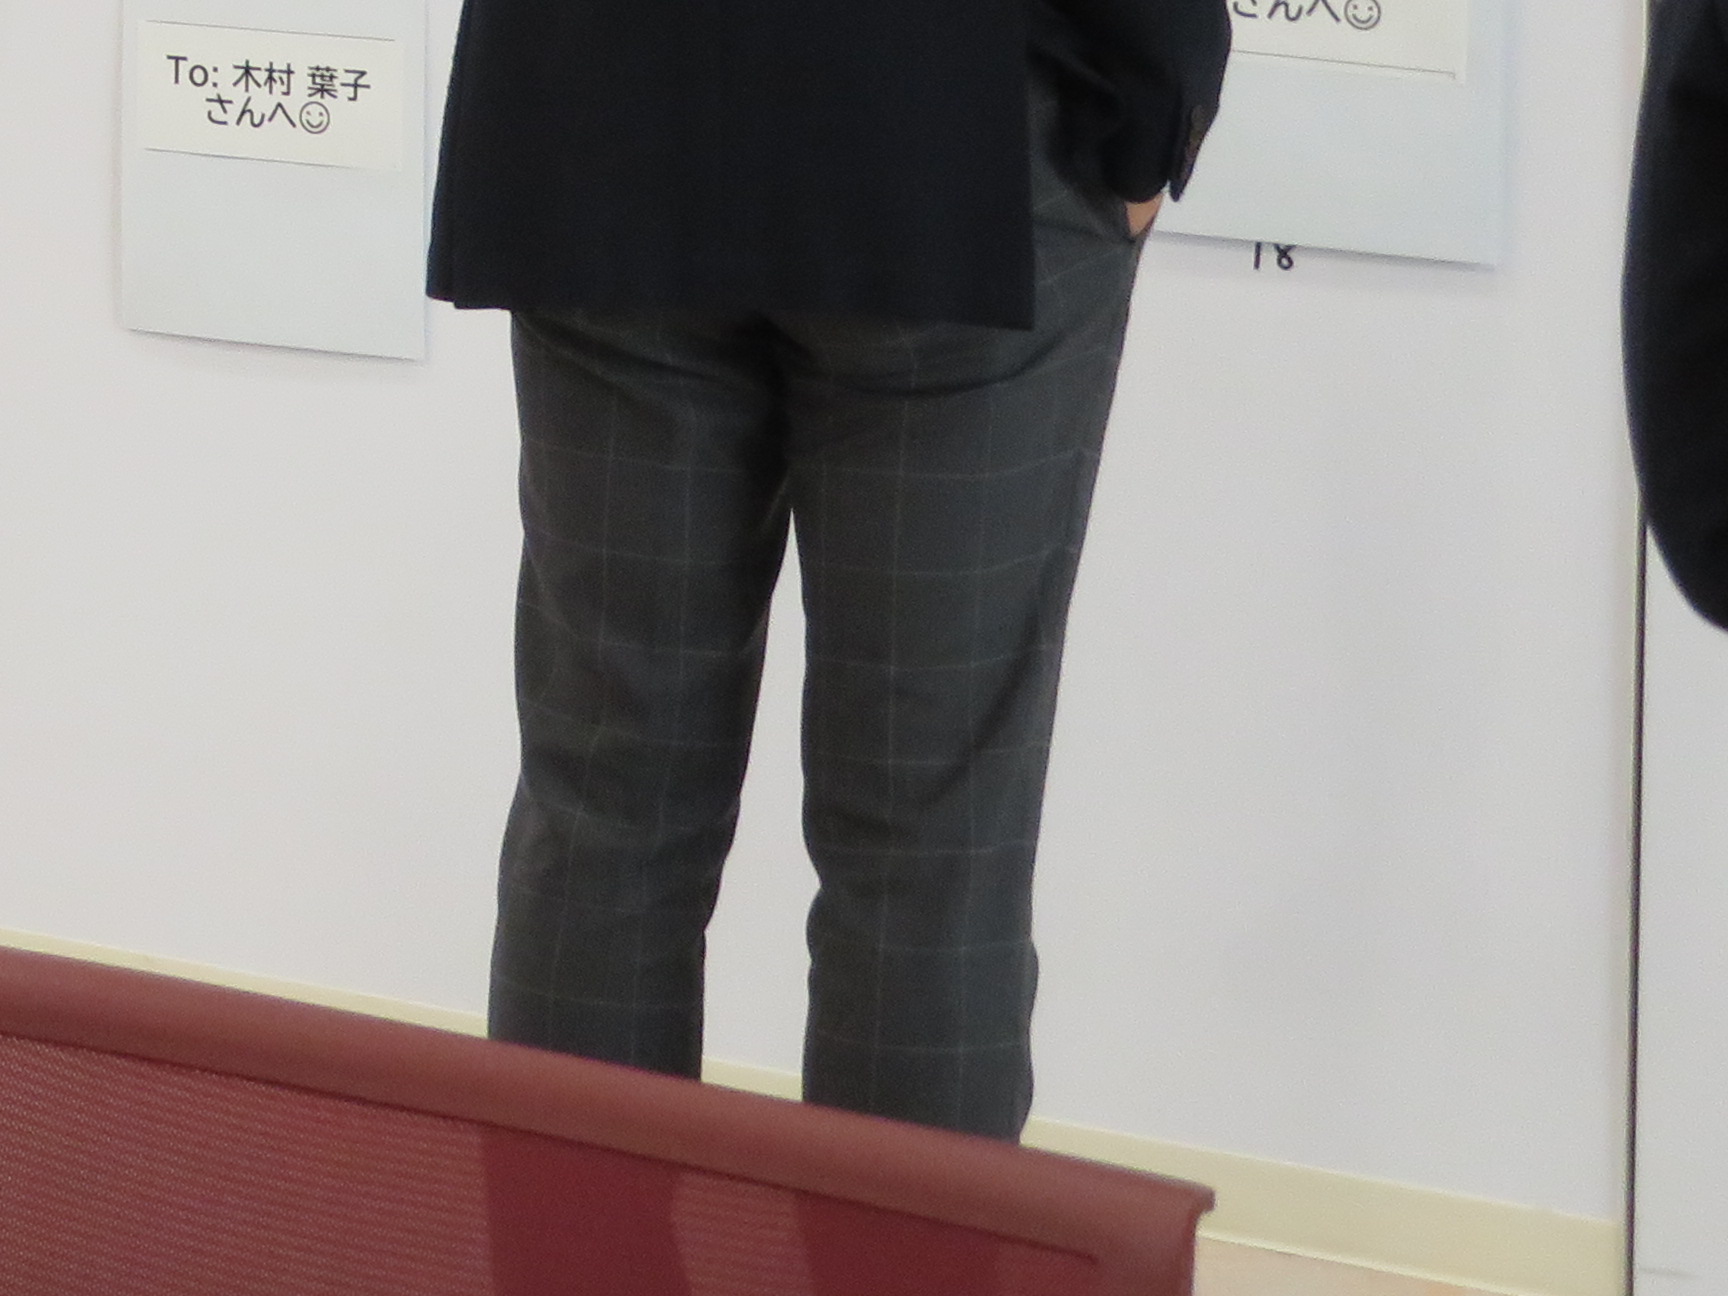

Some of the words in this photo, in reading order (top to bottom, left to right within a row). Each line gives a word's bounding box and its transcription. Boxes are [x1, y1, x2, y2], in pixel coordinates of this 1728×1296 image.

[165, 54, 220, 88] To:
[231, 59, 296, 97] 木村
[306, 64, 372, 102] 葉子
[205, 93, 297, 129] さんへ
